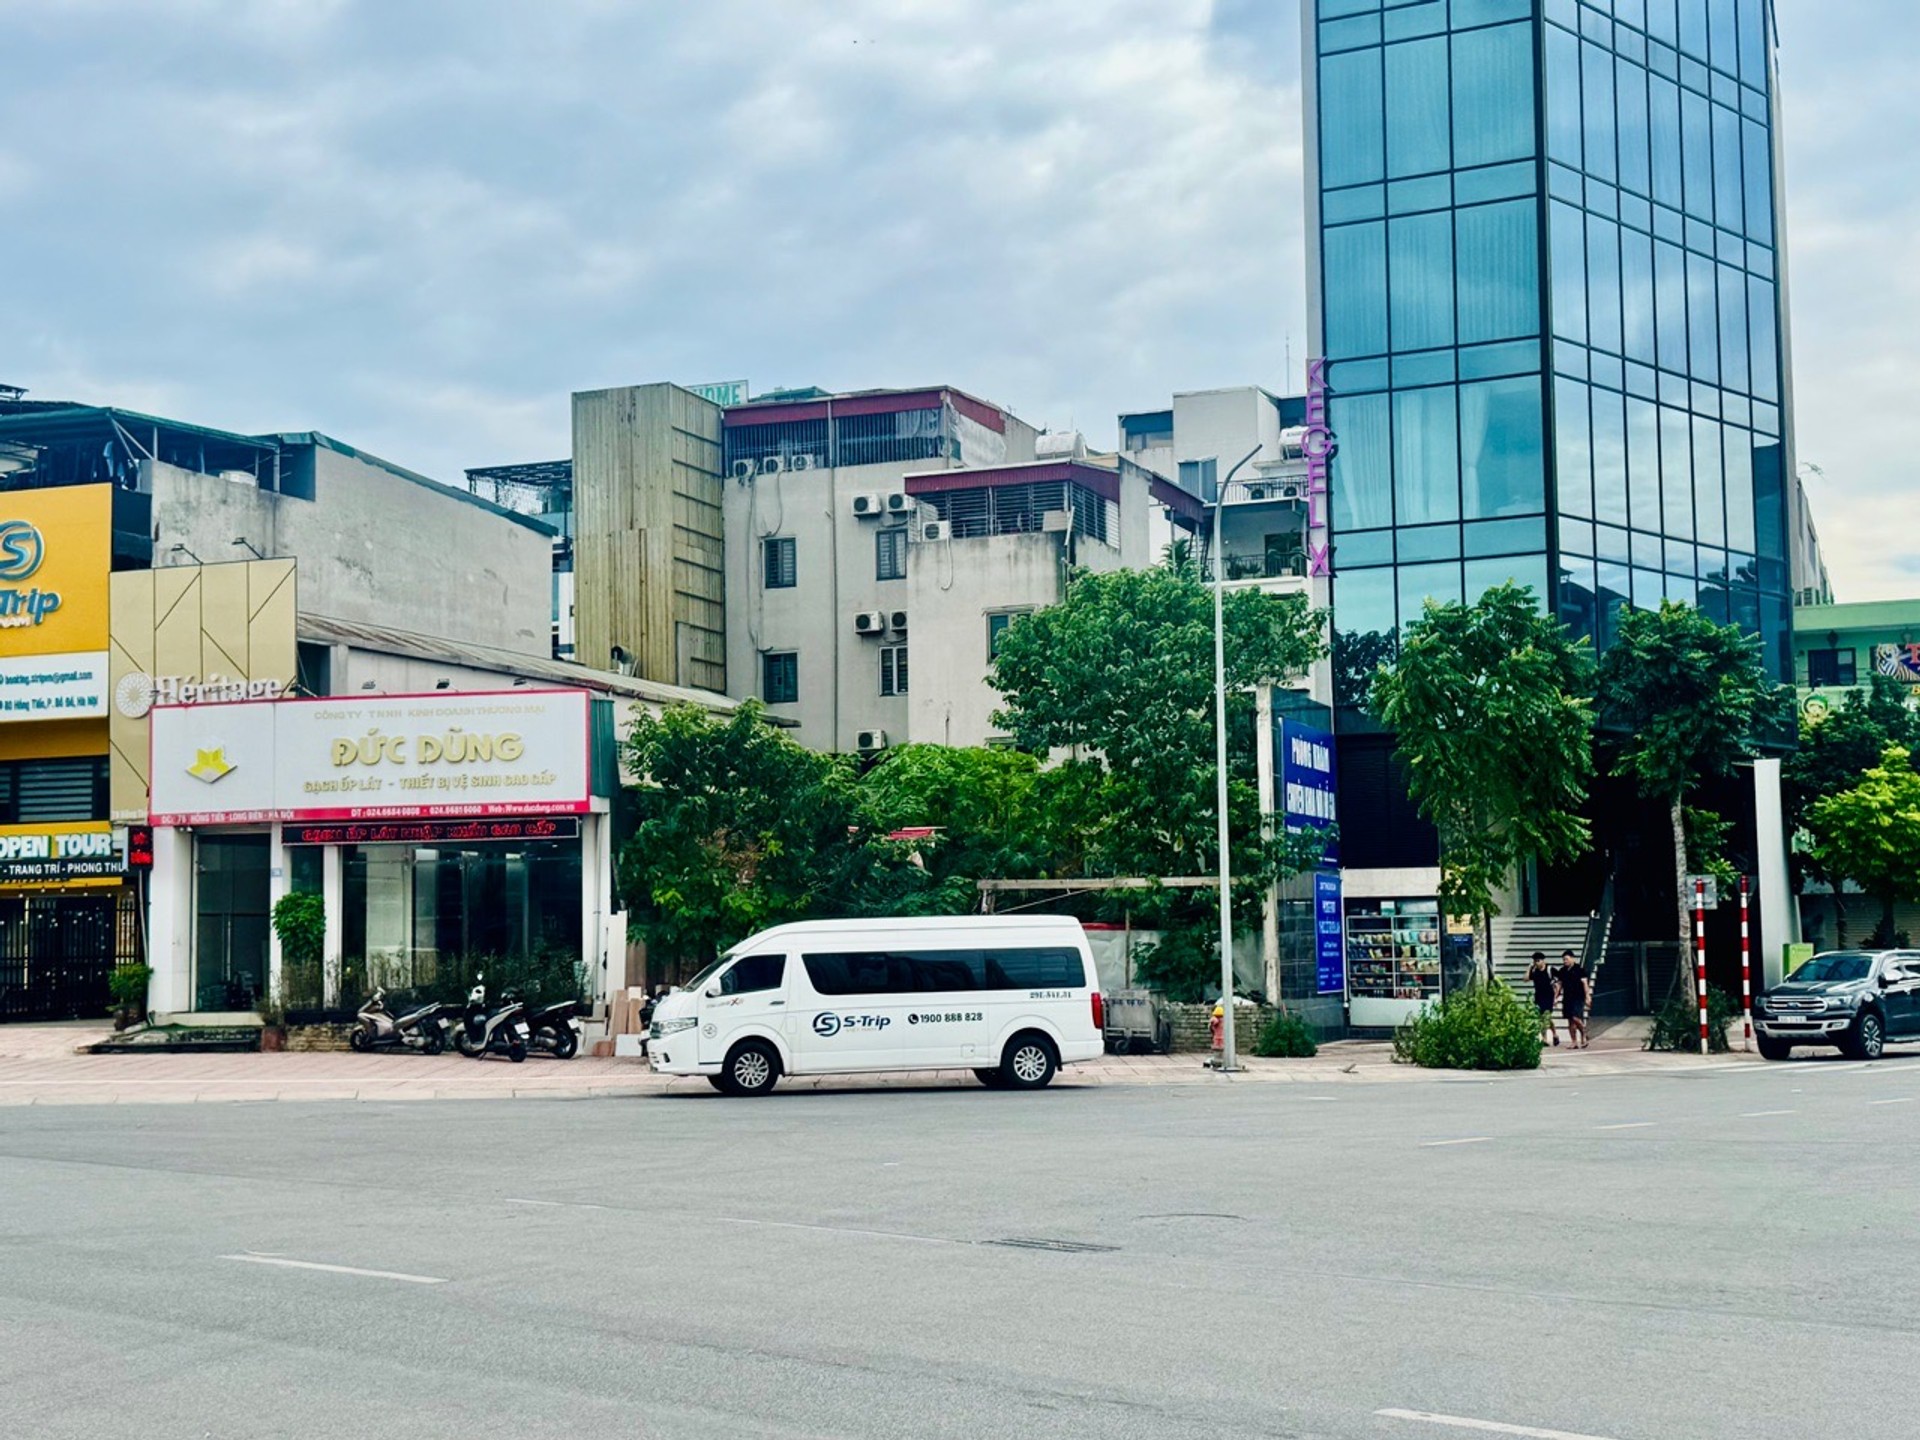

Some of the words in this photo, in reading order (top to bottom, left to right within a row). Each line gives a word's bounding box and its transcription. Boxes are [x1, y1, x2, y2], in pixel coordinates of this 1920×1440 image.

[346, 710, 362, 719] TY
[332, 727, 406, 767] ĐỨC
[417, 725, 525, 765] DŨNG
[304, 780, 338, 795] GẠCH
[359, 776, 382, 791] LÁT
[399, 772, 434, 789] THIẾT
[472, 775, 501, 788] SINH
[504, 774, 529, 787] CAO
[531, 769, 556, 786] CẤP
[55, 833, 111, 857] TOUR
[9, 865, 41, 875] TRANG
[44, 862, 60, 874] TRÍ
[67, 863, 102, 873] PHONG
[843, 1015, 891, 1031] S-Trip
[920, 1013, 942, 1023] 1900
[944, 1013, 963, 1022] 888
[965, 1012, 983, 1021] 828
